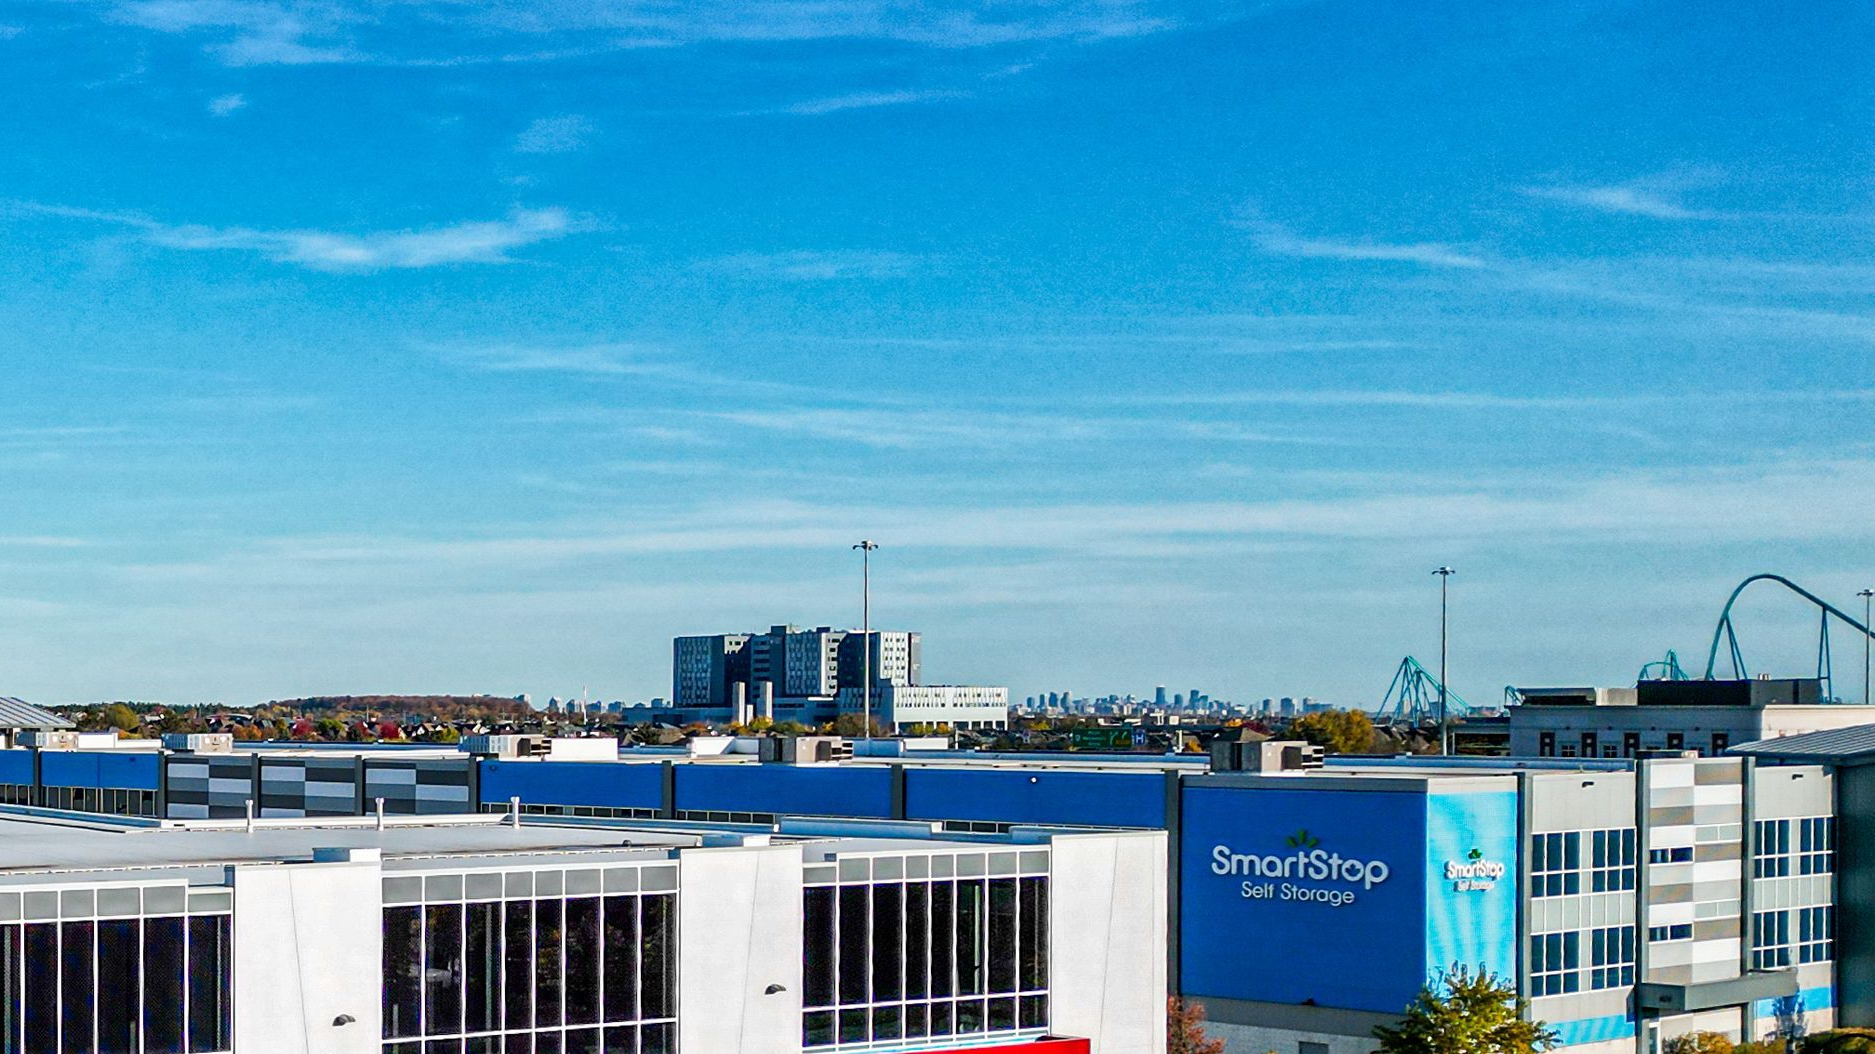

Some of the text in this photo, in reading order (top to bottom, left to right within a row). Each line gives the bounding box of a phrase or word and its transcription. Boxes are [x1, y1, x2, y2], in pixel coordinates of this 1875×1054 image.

[1211, 845, 1389, 906] SmartStop Self Storage
[1446, 860, 1504, 880] SmartStop
